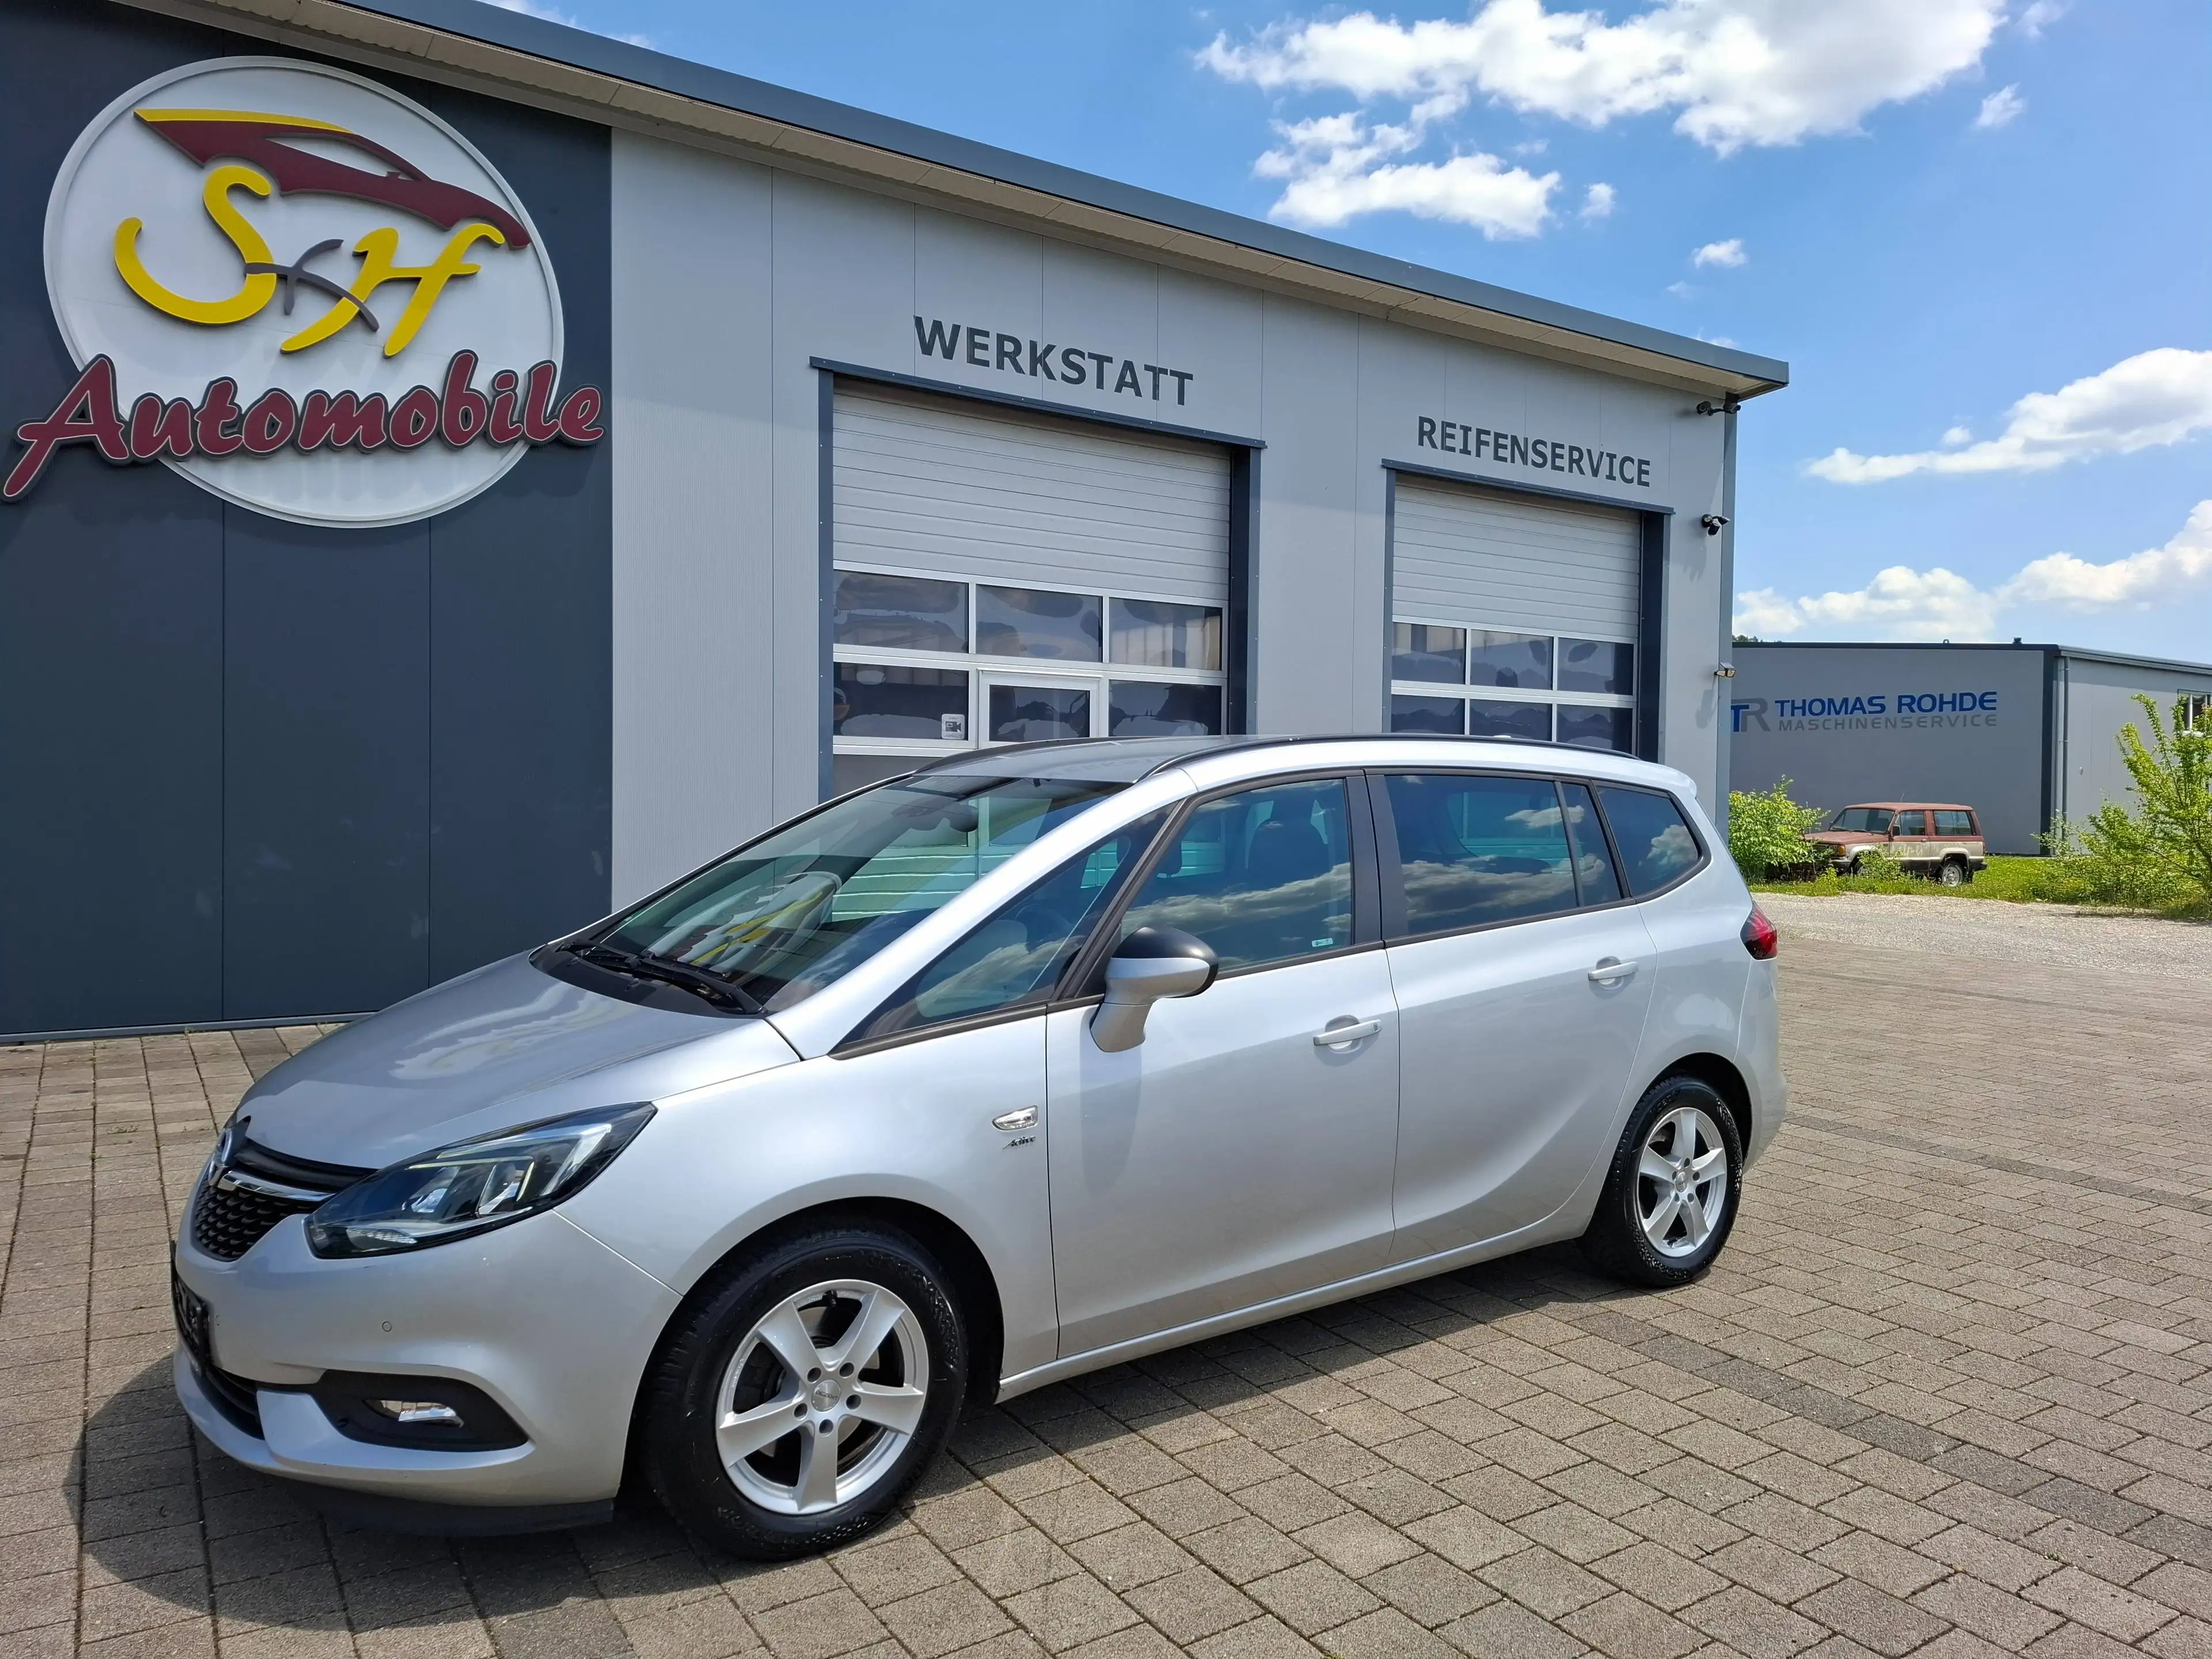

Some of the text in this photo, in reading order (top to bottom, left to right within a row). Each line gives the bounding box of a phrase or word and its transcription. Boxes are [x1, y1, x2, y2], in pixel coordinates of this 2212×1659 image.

[914, 315, 1194, 406] WERKSTATT
[2, 350, 606, 501] Automobile
[1418, 416, 1650, 487] REIFENSERVICE
[1730, 698, 1771, 732] TR
[1775, 691, 1997, 717] THOMAS ROHDE
[1779, 714, 1997, 731] MASCHINENSERVICE
